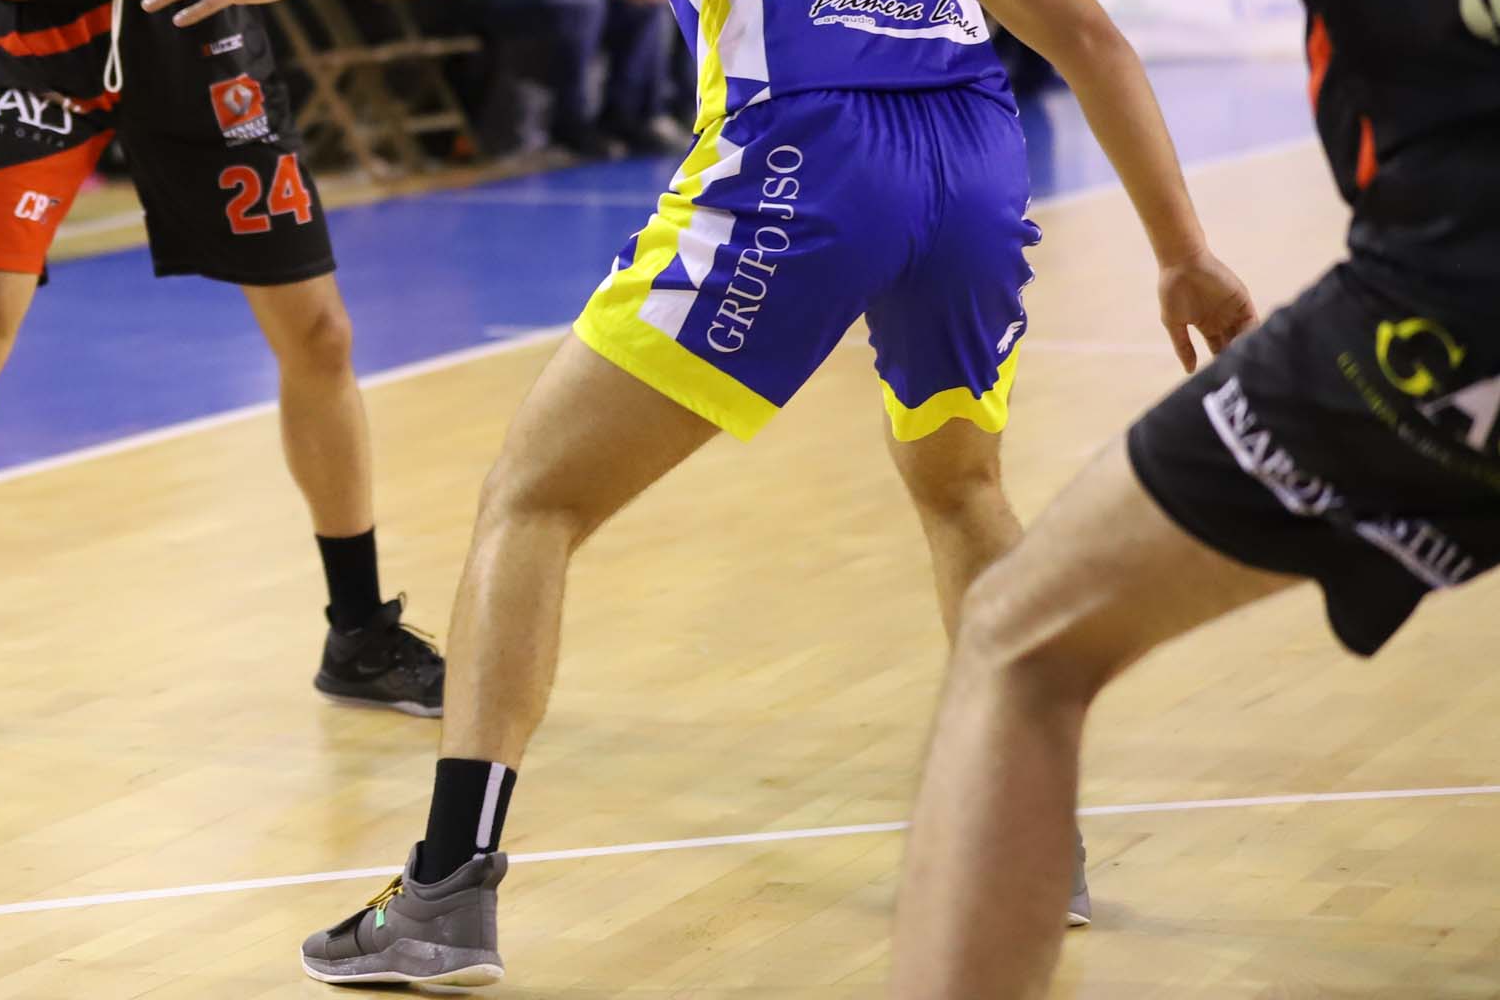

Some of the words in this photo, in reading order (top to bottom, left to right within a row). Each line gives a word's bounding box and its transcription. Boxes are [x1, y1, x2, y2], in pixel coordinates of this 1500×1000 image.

[219, 153, 312, 234] 24
[707, 226, 790, 353] GRUPO
[758, 144, 803, 220] JSO
